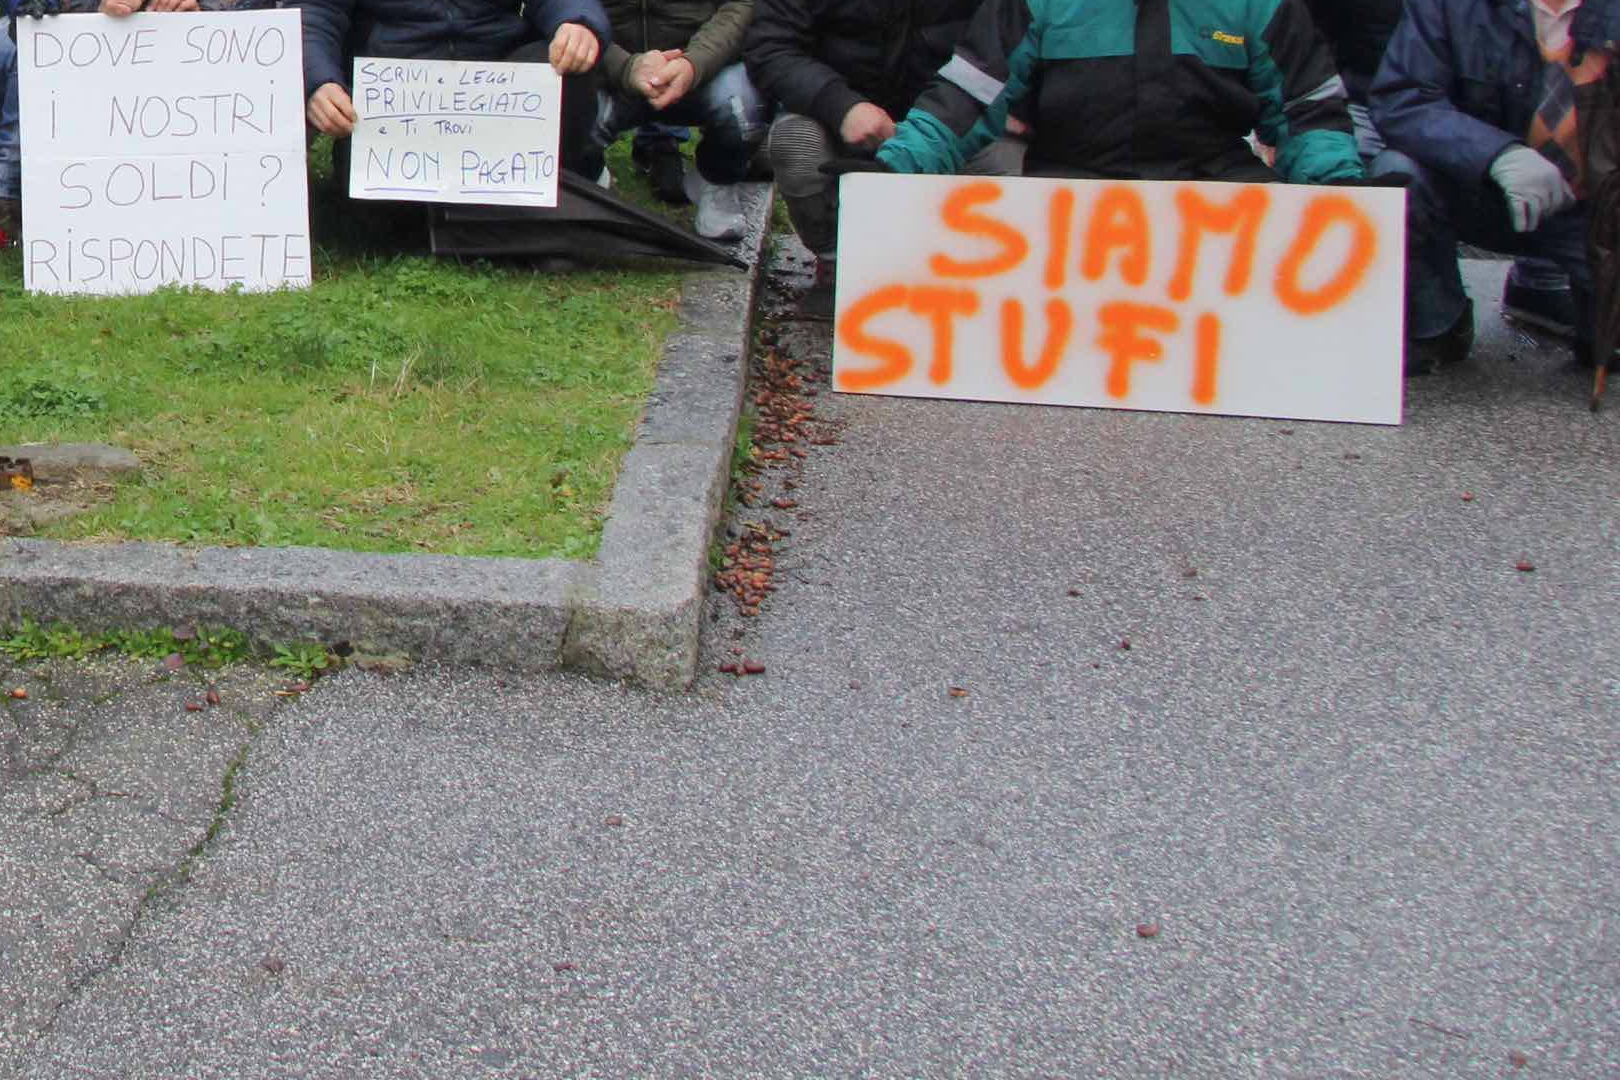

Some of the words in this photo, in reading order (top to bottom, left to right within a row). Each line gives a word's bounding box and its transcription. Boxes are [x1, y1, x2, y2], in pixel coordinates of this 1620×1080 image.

[34, 29, 158, 68] DOVE
[179, 24, 285, 67] SONO
[360, 62, 429, 85] SCRIVI
[459, 68, 516, 86] LEGGI
[364, 87, 542, 113] PRIVILEGIATO
[366, 146, 440, 181] NON
[460, 150, 555, 185] PAGATO
[928, 181, 1378, 317] SIAMO
[836, 283, 1223, 407] STUFI
